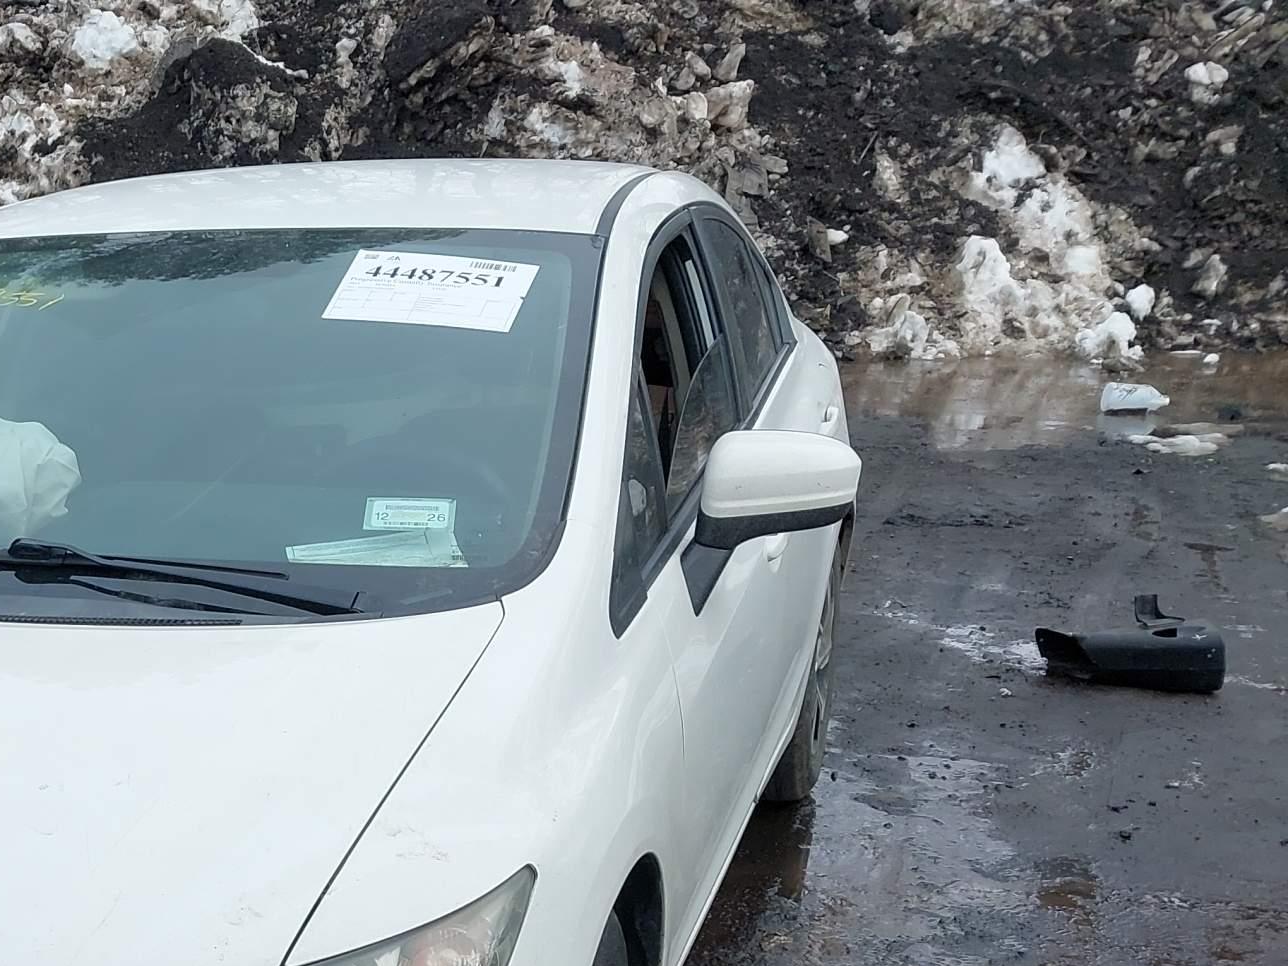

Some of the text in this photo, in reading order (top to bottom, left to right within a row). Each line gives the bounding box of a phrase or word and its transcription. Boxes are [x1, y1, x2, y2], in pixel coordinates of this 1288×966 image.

[364, 264, 506, 288] 44487551
[375, 511, 446, 522] 12 26
